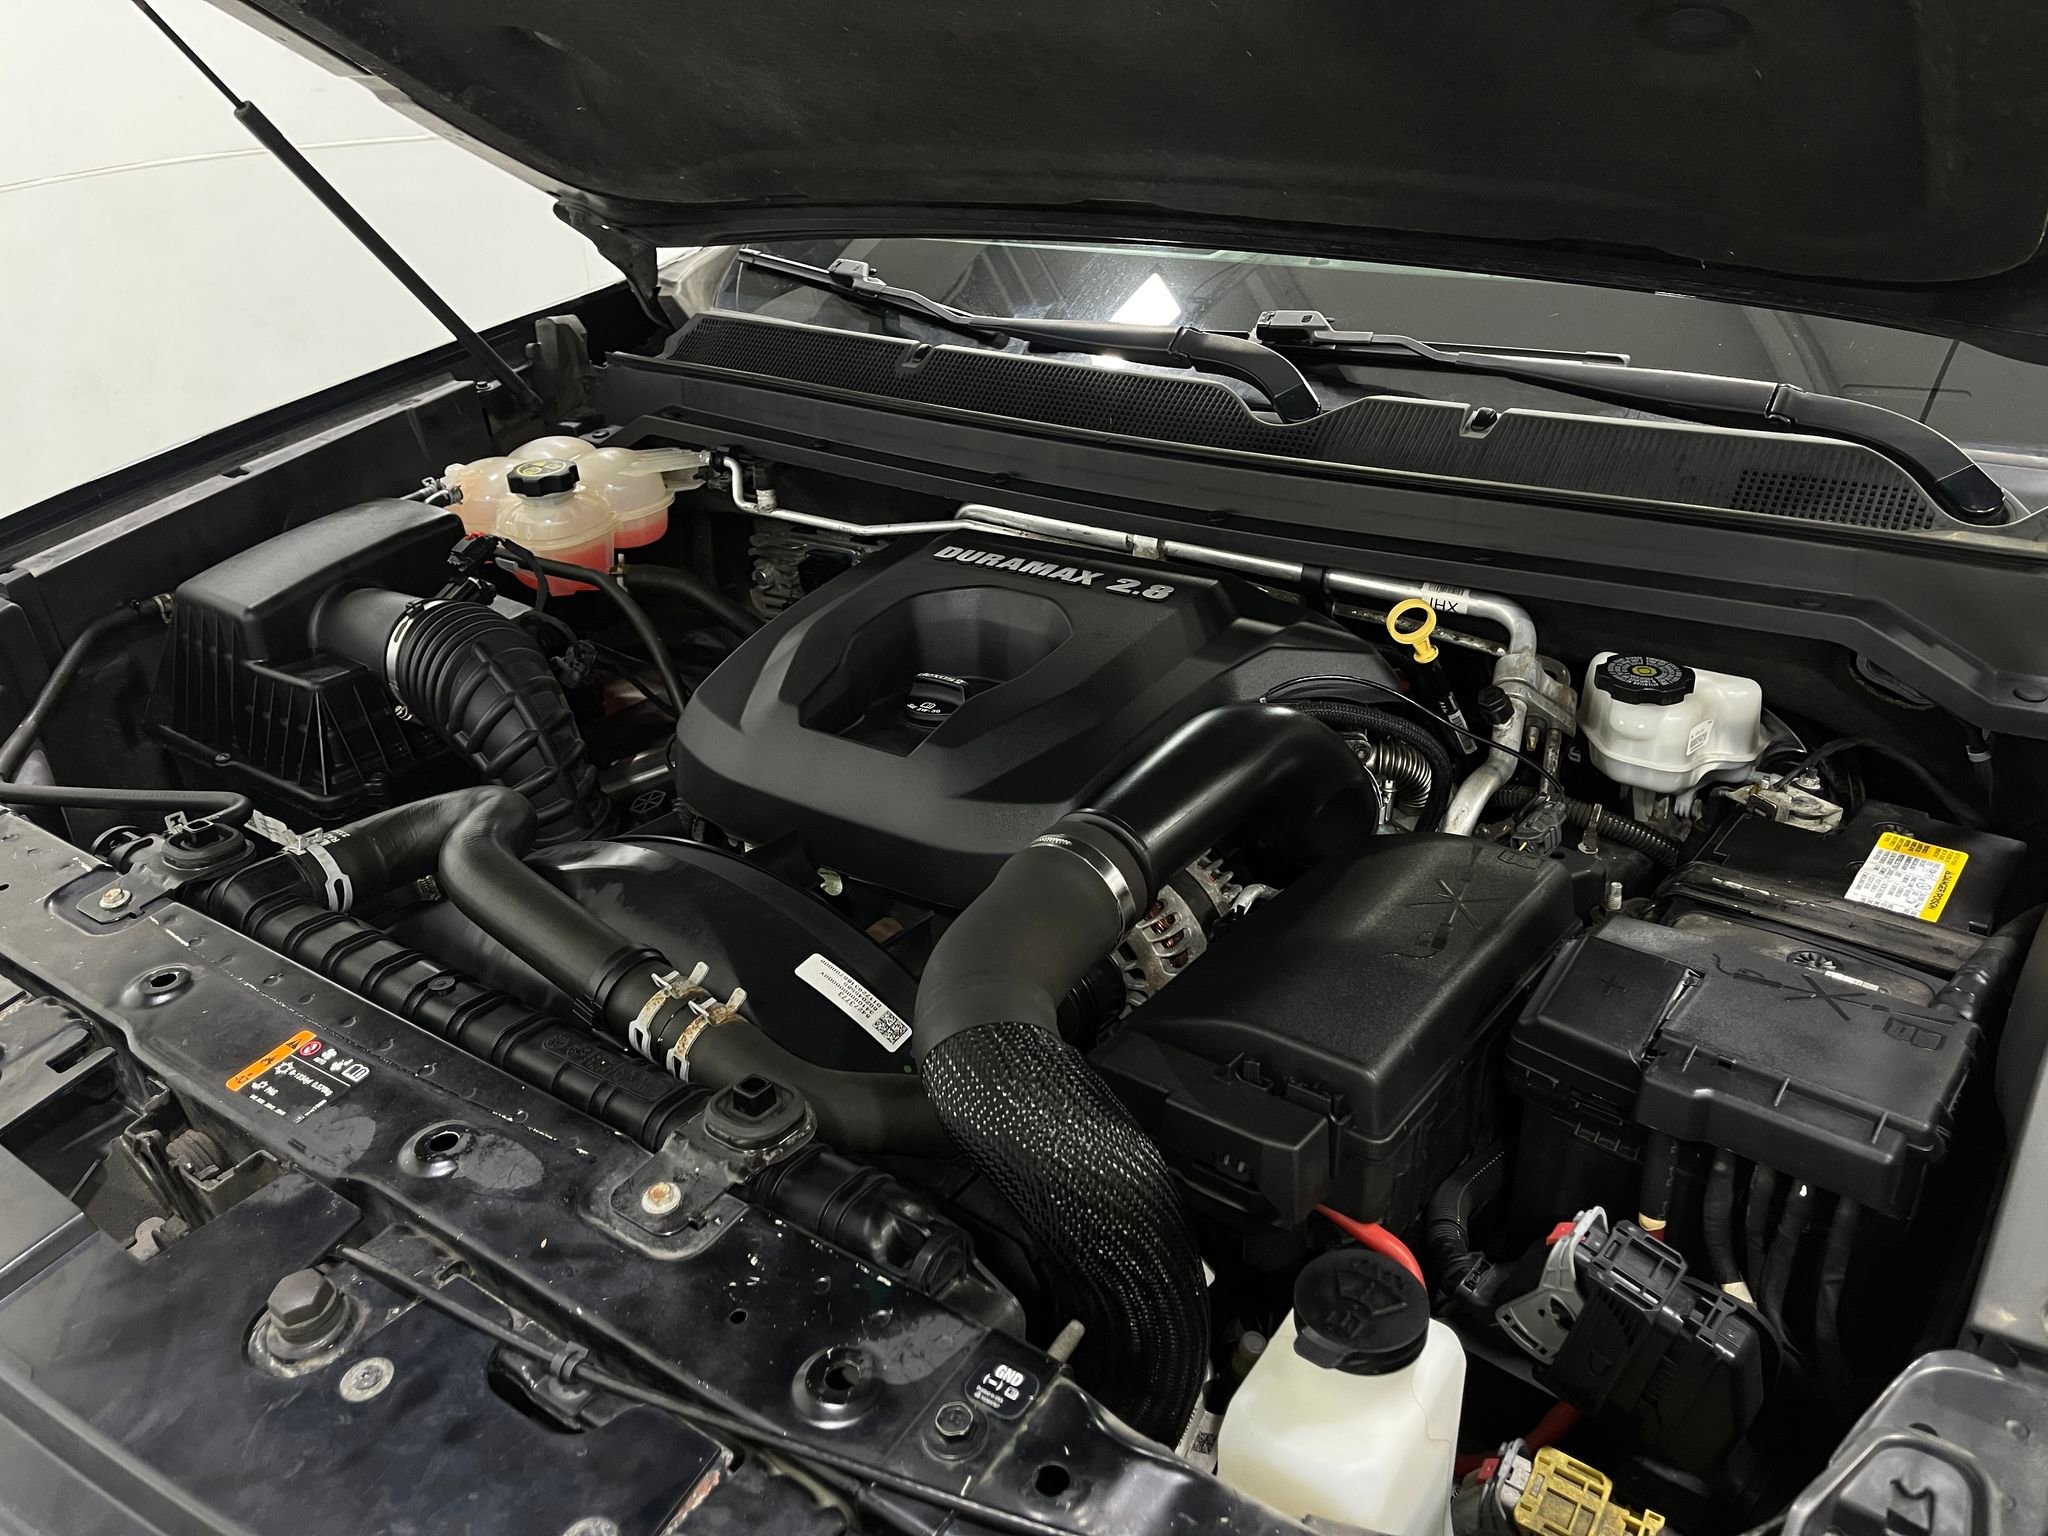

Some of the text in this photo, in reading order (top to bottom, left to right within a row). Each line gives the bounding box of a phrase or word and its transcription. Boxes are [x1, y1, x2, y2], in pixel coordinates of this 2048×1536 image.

[934, 546, 1175, 600] DURAMAX 2.8
[994, 1364, 1025, 1388] GND
